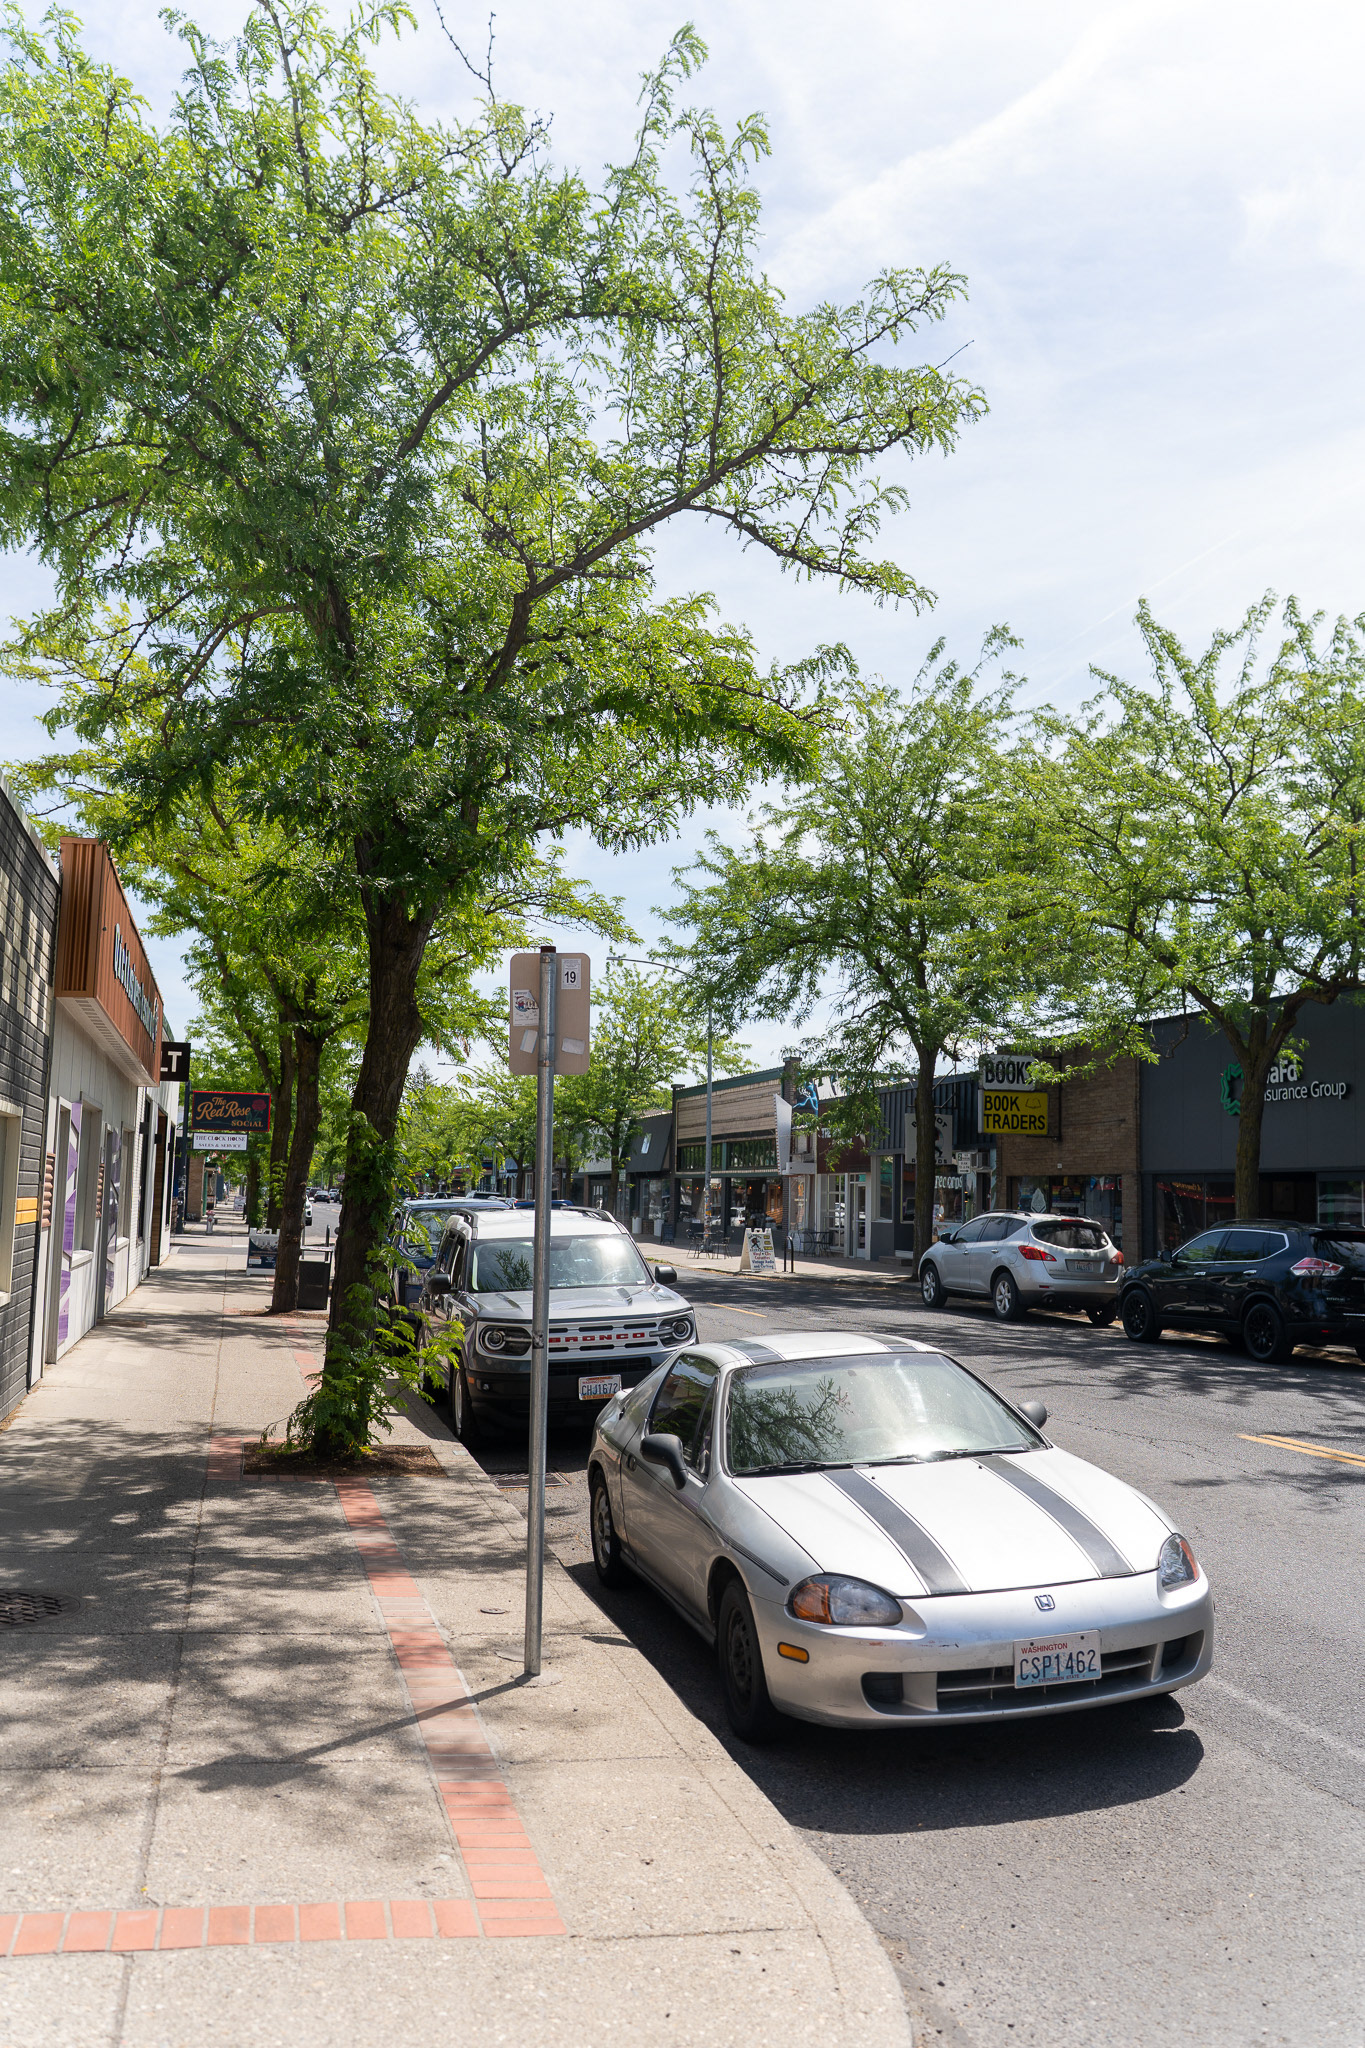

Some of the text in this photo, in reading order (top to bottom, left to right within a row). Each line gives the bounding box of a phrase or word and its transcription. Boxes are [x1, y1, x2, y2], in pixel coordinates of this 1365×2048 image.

[564, 970, 577, 984] 19
[1266, 1058, 1298, 1085] aFd
[1264, 1081, 1347, 1102] surance Group
[212, 1096, 227, 1106] The
[984, 1095, 1020, 1112] BOOK
[195, 1100, 251, 1121] Red Rose
[984, 1113, 1046, 1130] TRADERS
[548, 1332, 645, 1343] BRONCO
[581, 1382, 618, 1396] CHJ1672
[1021, 1643, 1068, 1654] WASHINGTON
[1020, 1649, 1097, 1680] CSP1462
